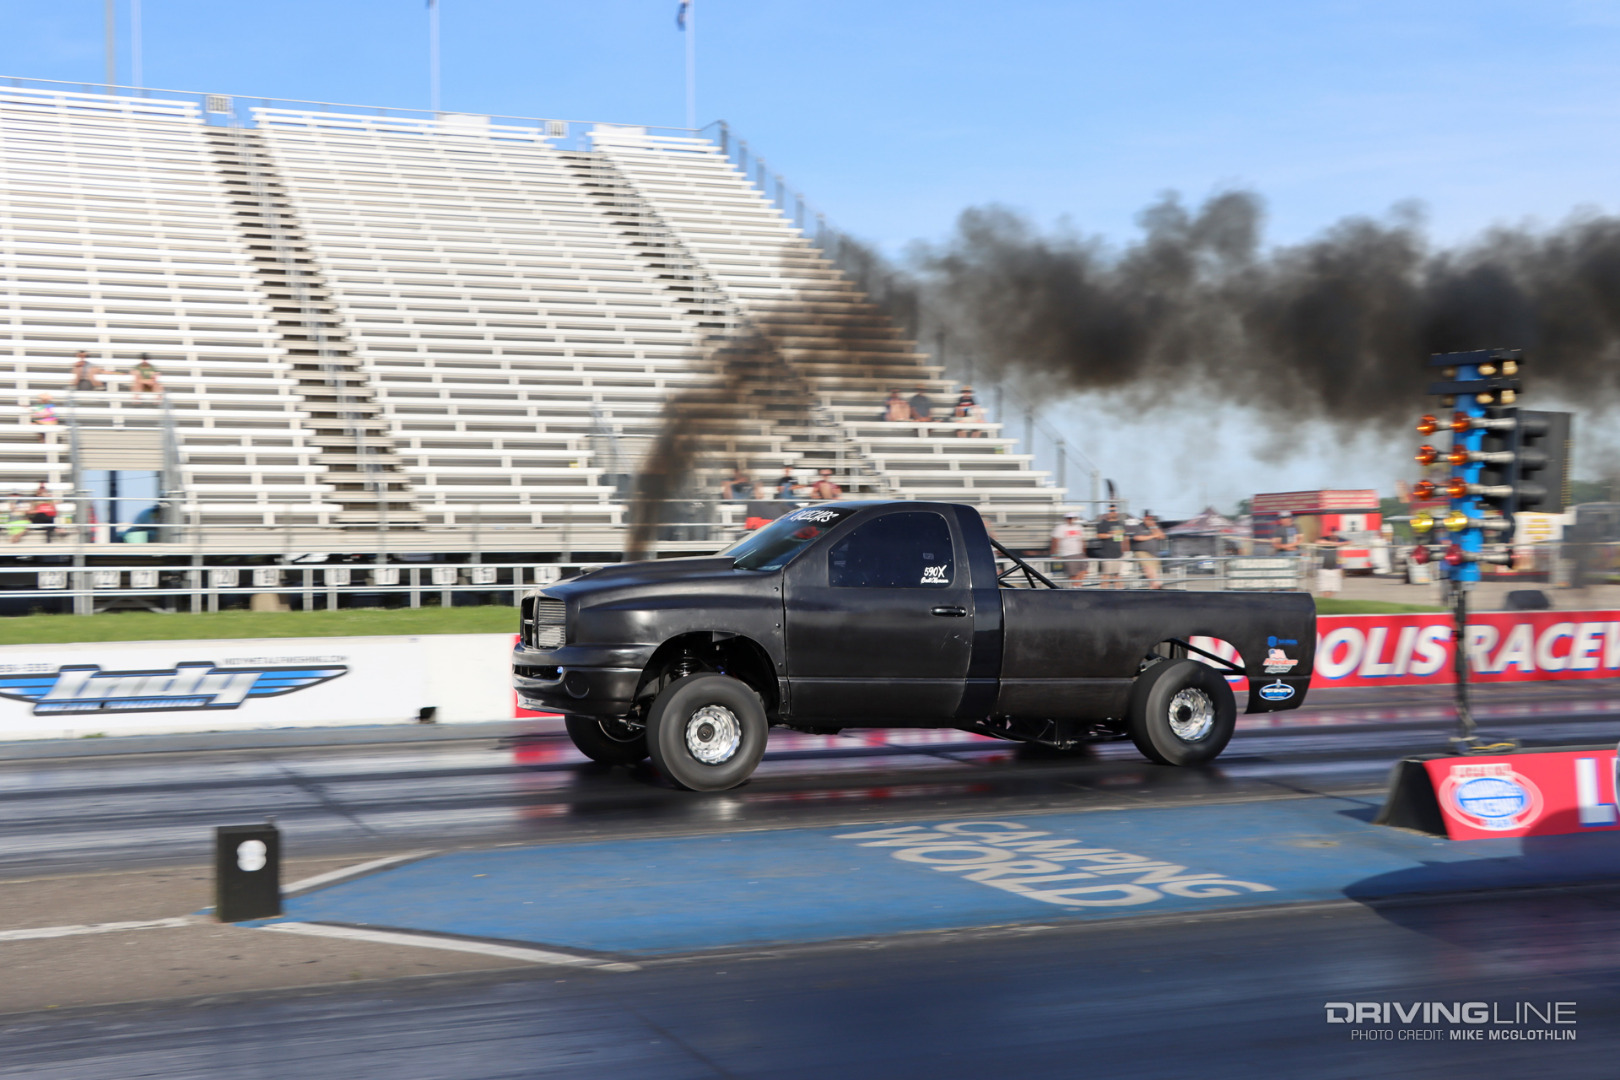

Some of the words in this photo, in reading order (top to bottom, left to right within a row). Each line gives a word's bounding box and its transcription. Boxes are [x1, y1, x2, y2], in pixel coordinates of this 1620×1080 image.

[924, 565, 947, 578] 590X
[1315, 625, 1452, 679] OLIS
[39, 664, 263, 707] Indy
[1574, 757, 1620, 827] L
[832, 825, 1163, 907] WORLD
[934, 821, 1278, 898] CAMPING
